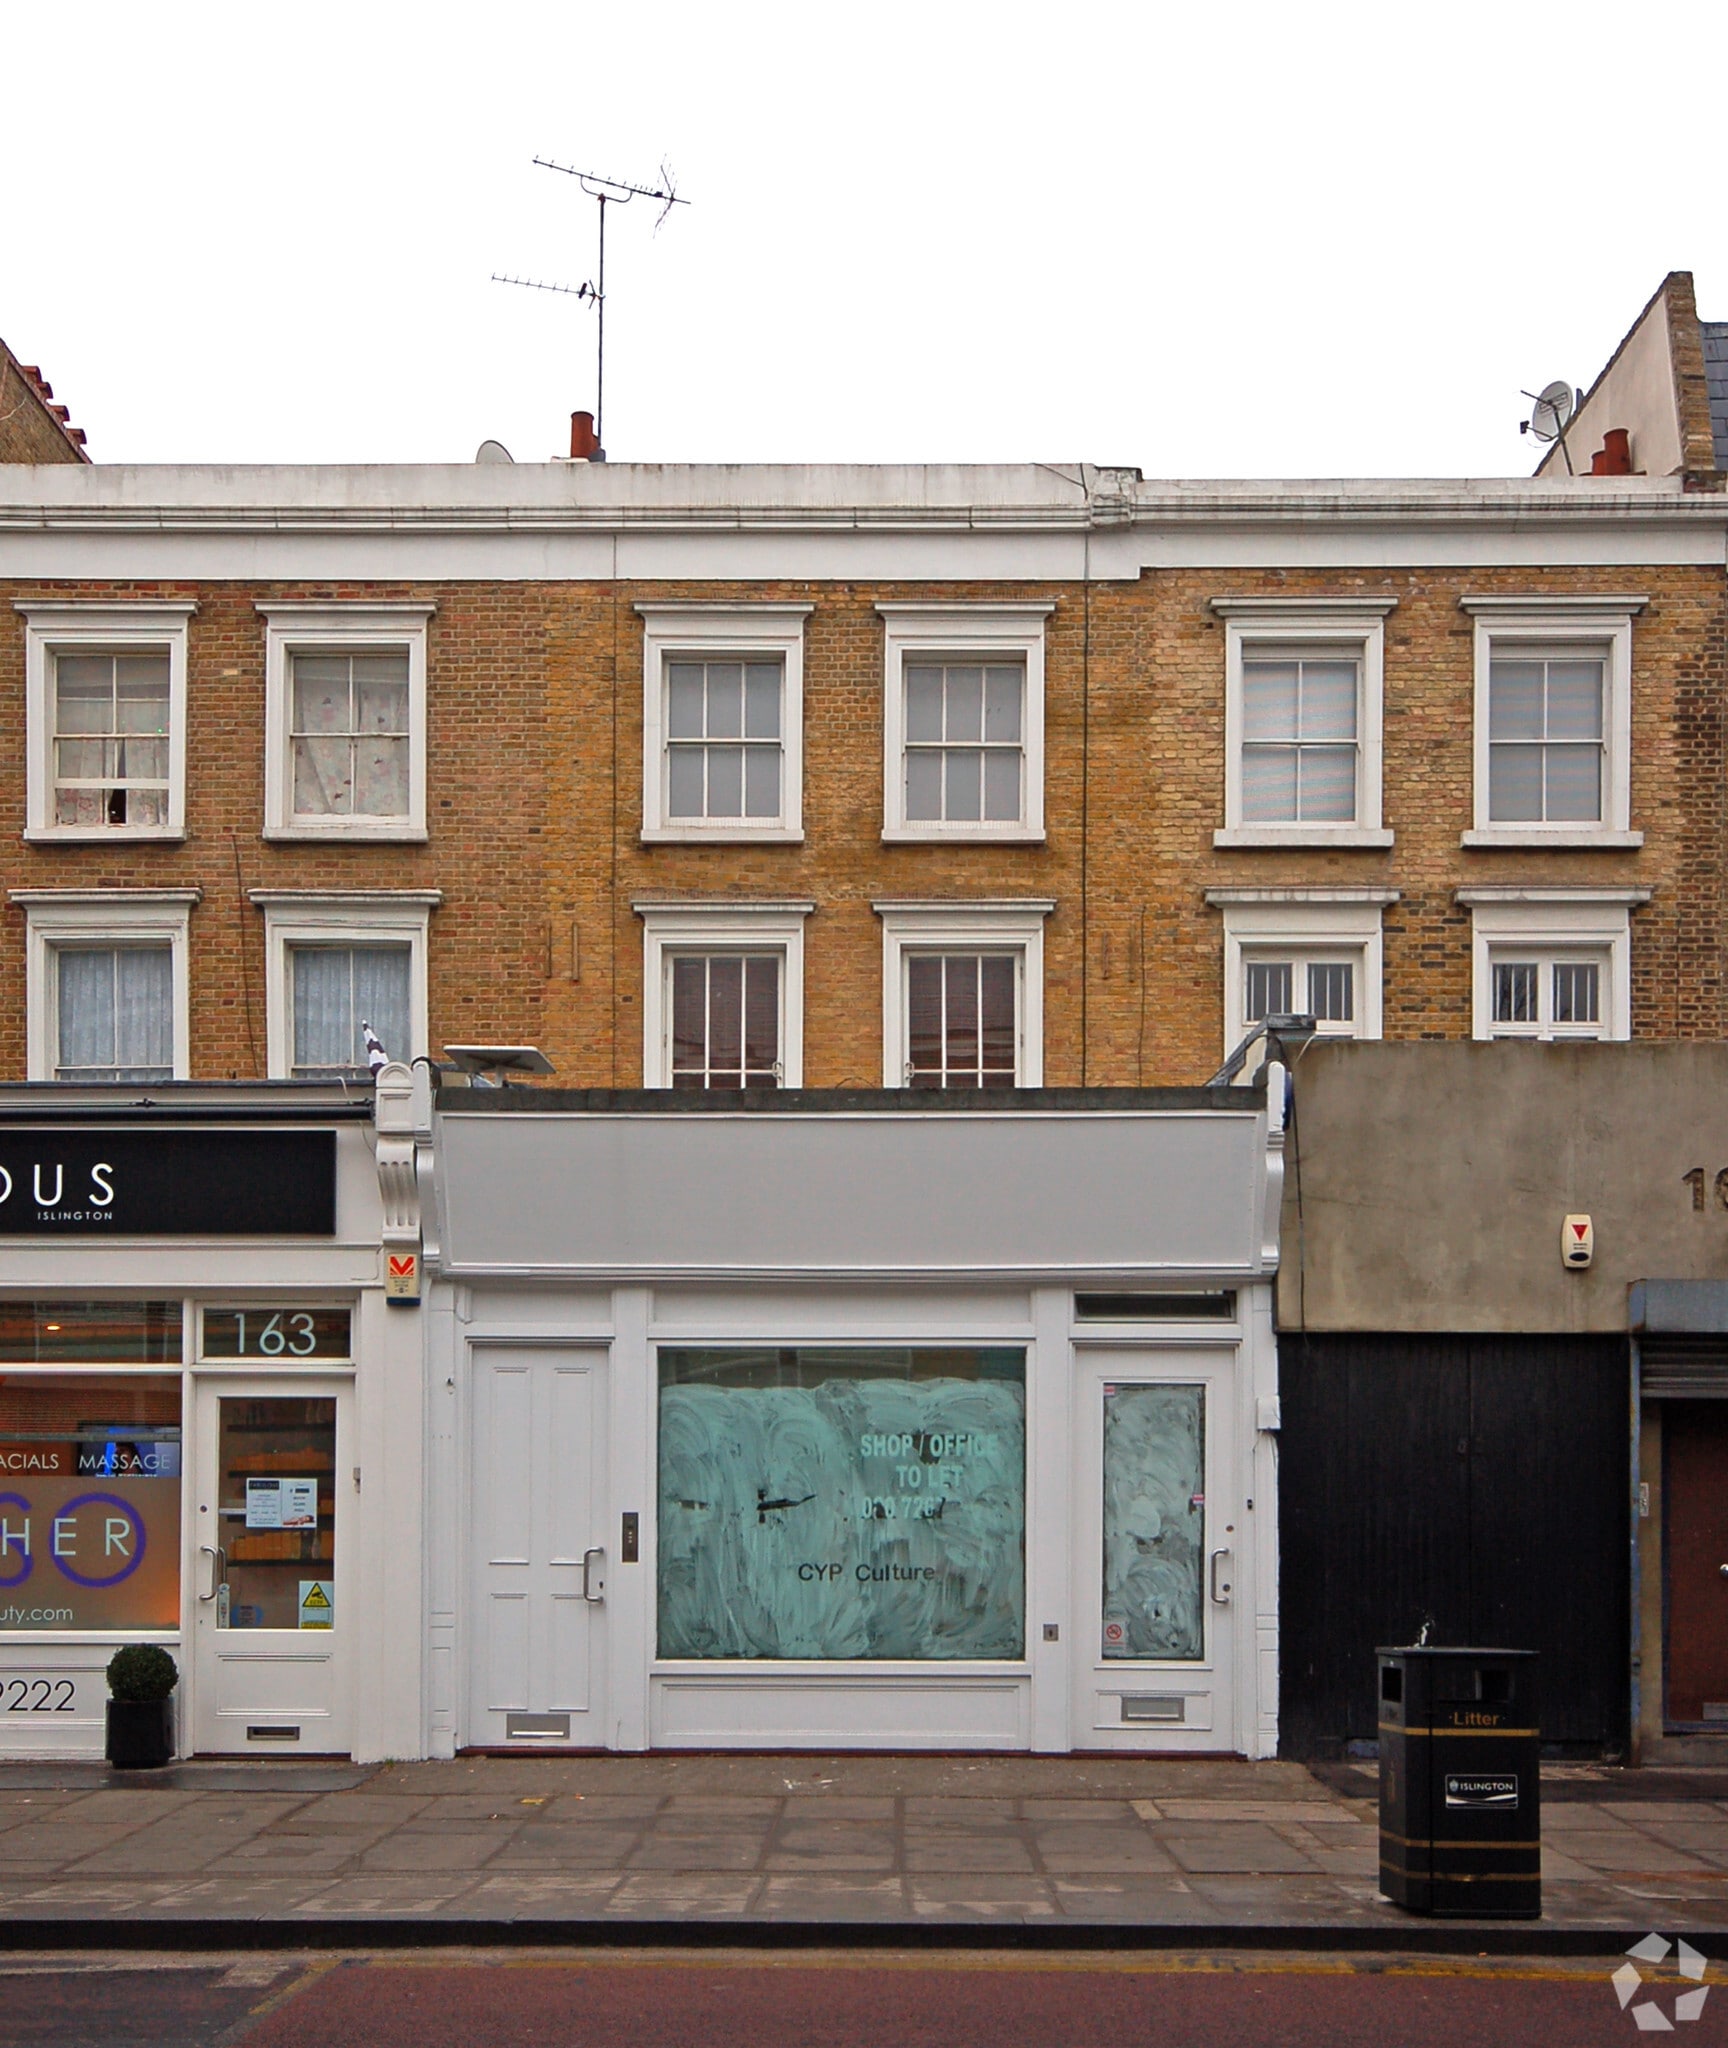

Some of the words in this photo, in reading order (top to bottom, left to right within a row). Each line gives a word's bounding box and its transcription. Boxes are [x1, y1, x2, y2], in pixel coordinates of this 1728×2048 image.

[37, 1211, 113, 1220] ISLINGTON
[233, 1313, 317, 1356] 163
[861, 1433, 914, 1457] SHOP
[929, 1433, 999, 1457] OFFICE
[78, 1453, 171, 1470] MASSAGE
[895, 1465, 922, 1488] TO
[928, 1465, 964, 1488] LET
[2, 1518, 131, 1556] HER
[798, 1563, 843, 1581] CYP
[855, 1563, 935, 1581] Culture
[0, 1679, 75, 1711] 222
[1454, 1712, 1500, 1726] Litter
[1460, 1783, 1513, 1791] ISLINGTON
